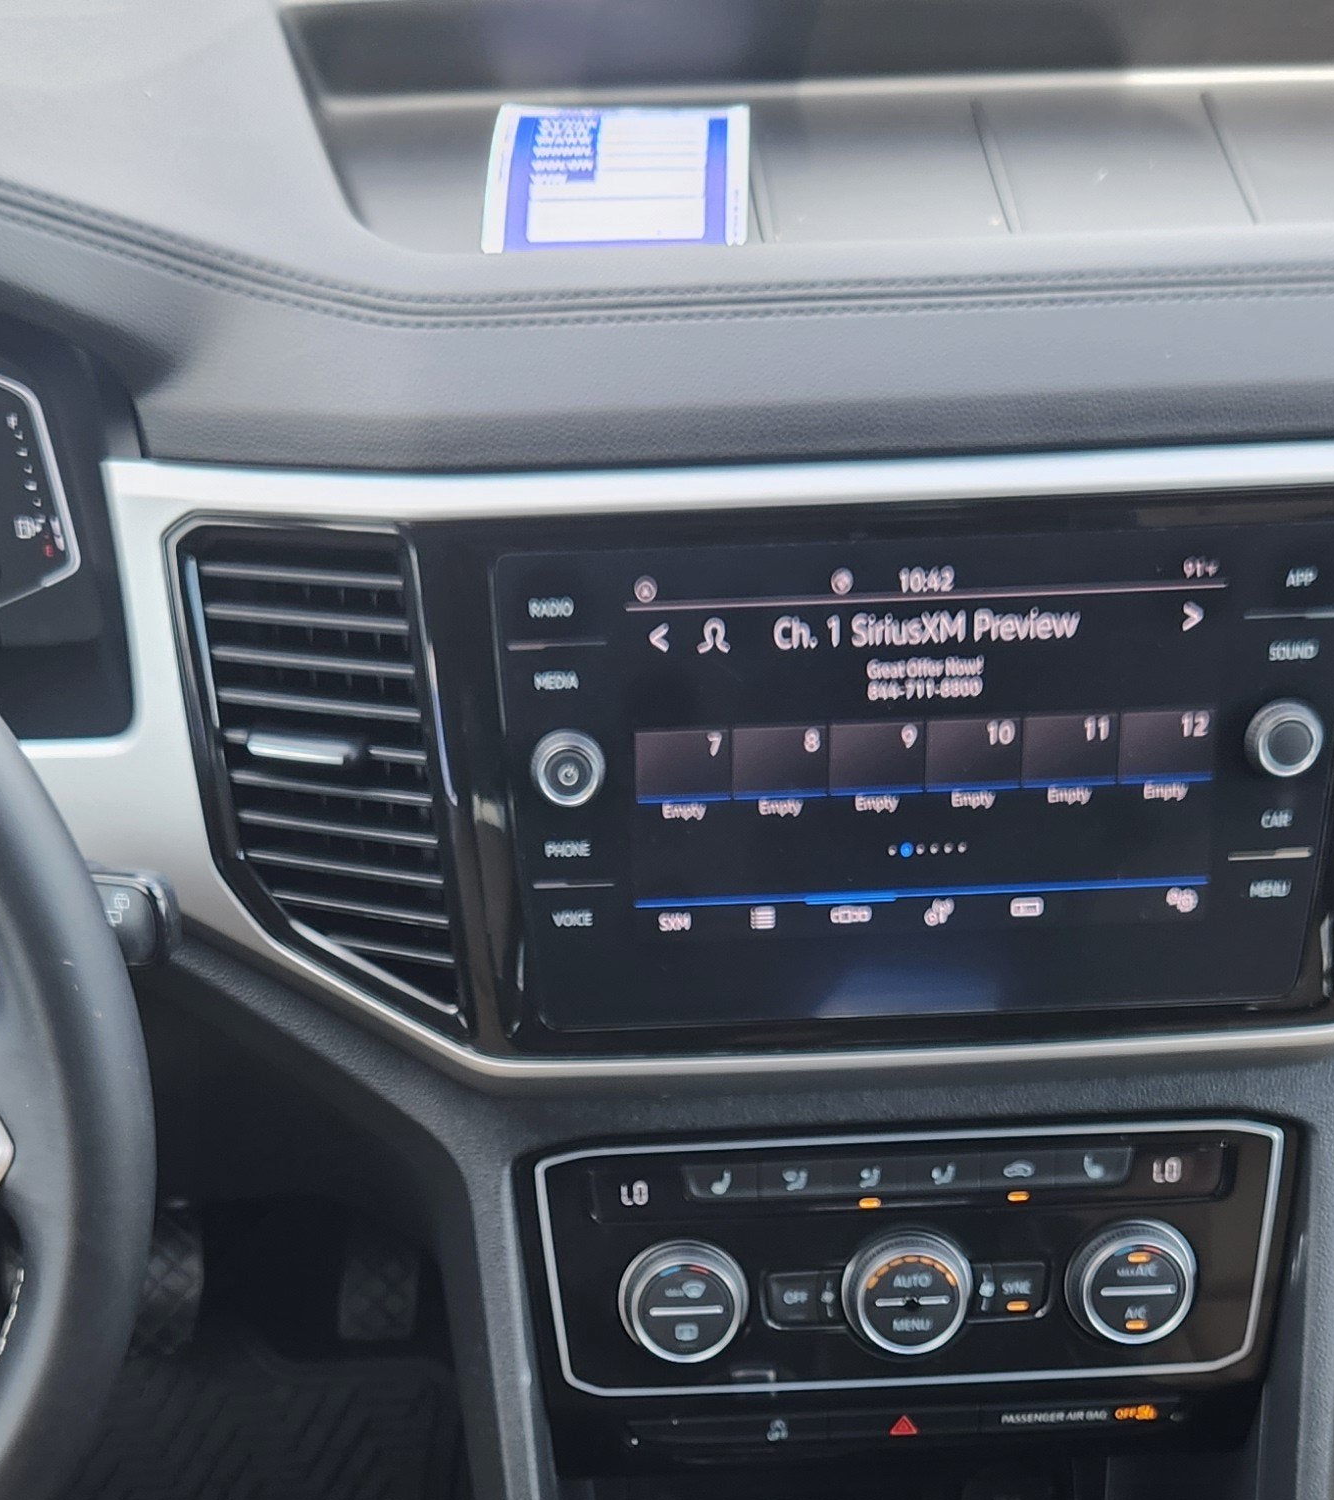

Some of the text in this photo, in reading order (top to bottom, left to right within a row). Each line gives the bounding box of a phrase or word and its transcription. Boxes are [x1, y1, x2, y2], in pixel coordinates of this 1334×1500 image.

[899, 565, 955, 593] 10:42
[1286, 567, 1317, 588] APP
[528, 597, 574, 618] RADIO
[773, 606, 1081, 650] Ch. 1 SiriusXM Preview
[1269, 639, 1319, 662] SOUND
[867, 658, 906, 680] Great
[906, 656, 944, 678] Offer
[533, 671, 579, 690] MEDIA
[987, 719, 1015, 745] 10
[1084, 714, 1110, 742] 11
[1181, 710, 1210, 738] 12
[707, 731, 722, 757] 7
[803, 727, 820, 753] 8
[901, 723, 917, 749] 9
[951, 789, 996, 809] Empty
[1047, 784, 1093, 805] Empty
[1143, 781, 1188, 801] Empty
[662, 801, 707, 821] Empty
[757, 797, 804, 817] Empty
[854, 794, 900, 813] Empty
[1260, 809, 1294, 829] CAR
[544, 840, 591, 857] PHONE
[1249, 878, 1292, 898] MENU
[551, 909, 593, 927] VOICE
[658, 912, 692, 931] SXM
[893, 1272, 933, 1289] AUTO
[1001, 1279, 1032, 1296] SYNC
[783, 1289, 808, 1305] OFF
[1124, 1305, 1148, 1320] A/C
[892, 1317, 934, 1332] MENU
[1001, 1407, 1136, 1424] PASSENGER AIR BAG OFF
